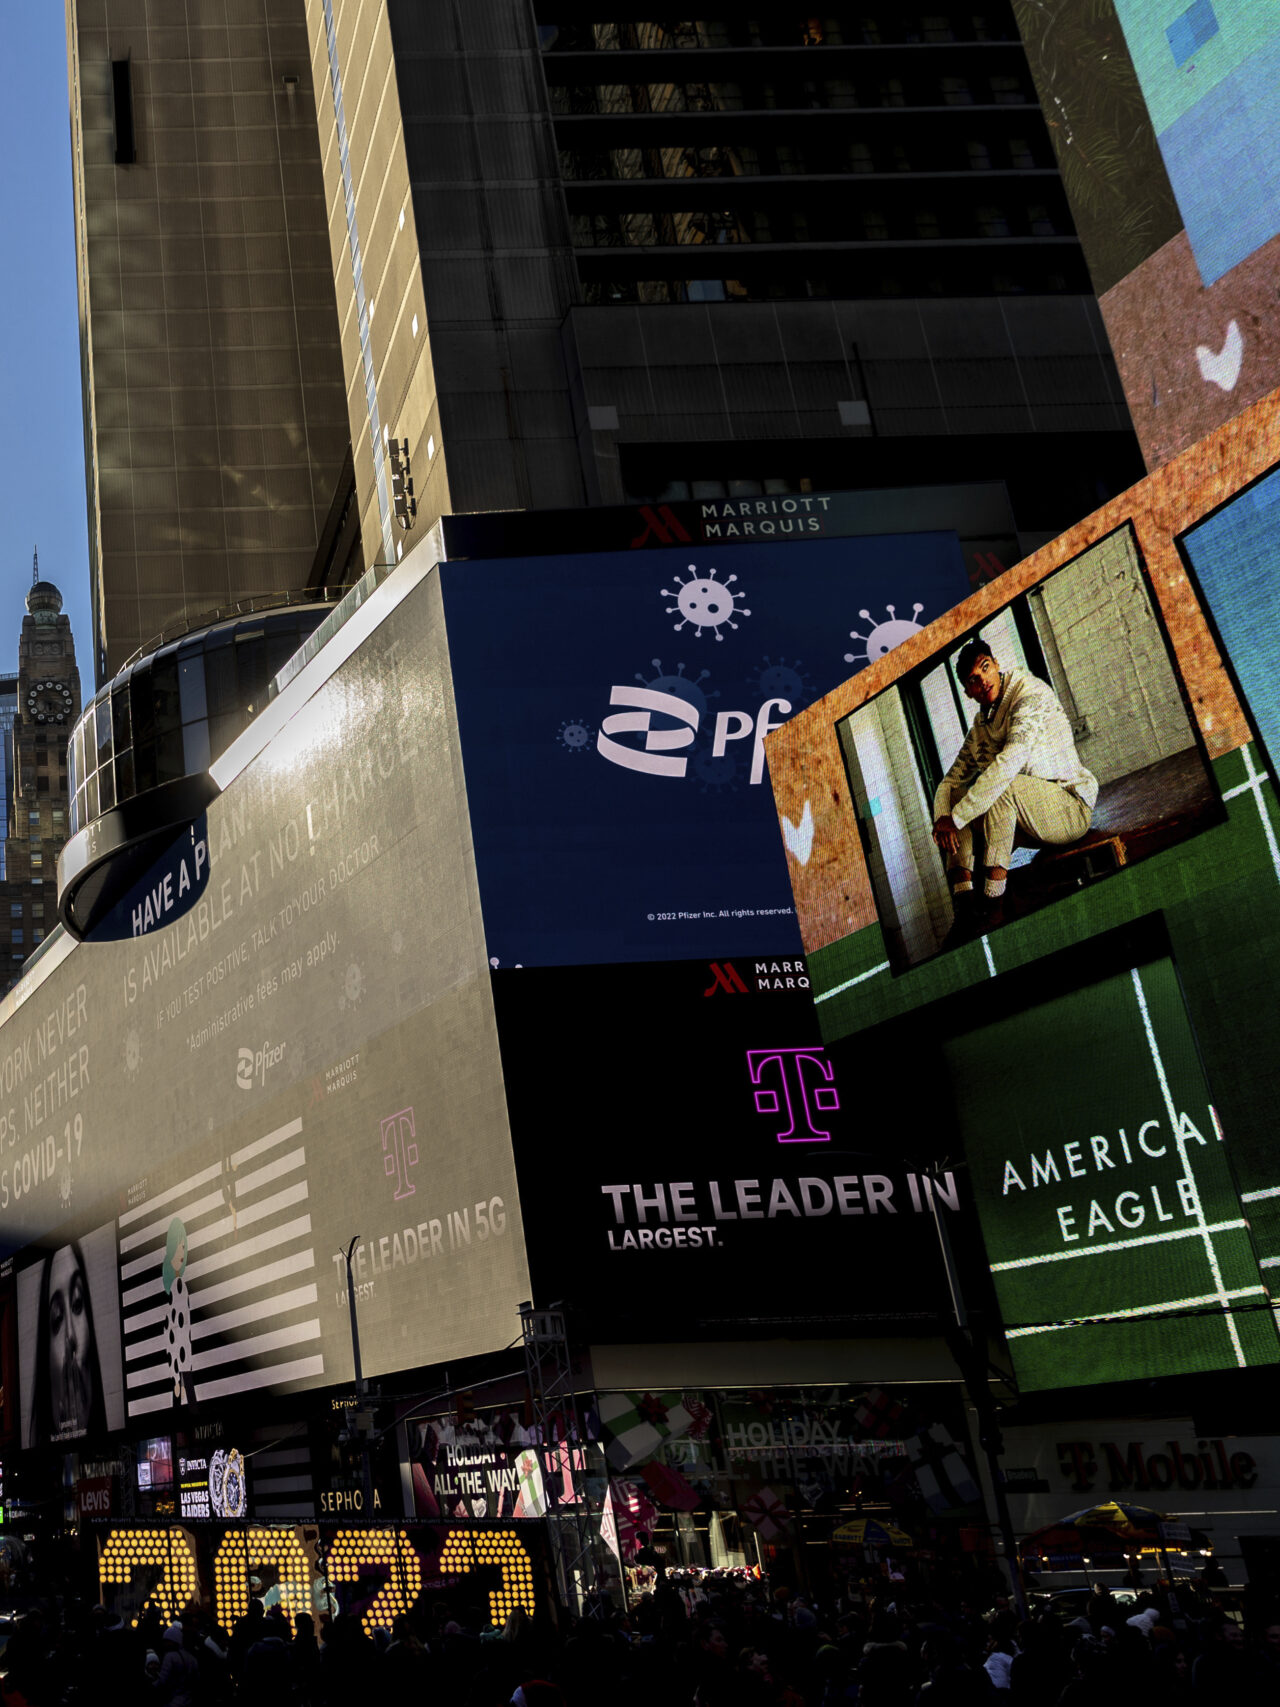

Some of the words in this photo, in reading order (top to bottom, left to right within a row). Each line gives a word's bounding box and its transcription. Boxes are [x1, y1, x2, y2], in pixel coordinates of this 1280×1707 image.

[701, 496, 831, 519] MARRIOTT
[705, 516, 821, 538] MARQUIS
[132, 872, 174, 942] HAVE
[179, 859, 190, 898] A
[657, 912, 676, 920] 2022
[678, 911, 701, 920] Pfizer
[703, 910, 717, 919] Inc.
[718, 909, 730, 918] All
[731, 908, 755, 919] rights
[756, 906, 794, 916] reserved.
[123, 967, 138, 1008] IS
[142, 880, 234, 993] AVAILABLE
[240, 850, 262, 906] AT
[166, 996, 182, 1022] YOU
[183, 977, 204, 1008] TEST
[252, 917, 278, 952] TALK
[279, 903, 293, 929] TO
[257, 977, 279, 1003] fees
[281, 956, 303, 985] may
[307, 930, 341, 967] apply.
[755, 961, 805, 974] MARR
[758, 976, 810, 990] MARQ
[36, 983, 88, 1066] NEVER
[255, 1040, 287, 1088] Pfizer
[326, 1053, 361, 1081] MARRIOTT
[24, 1044, 91, 1136] NEITHER
[327, 1069, 358, 1095] MARQUIS
[13, 1112, 84, 1202] COVID-19
[601, 1181, 700, 1224] THE
[708, 1174, 898, 1221] LEADER
[906, 1171, 962, 1214] IN
[1057, 1178, 1202, 1242] EAGLE
[370, 1217, 445, 1275] LEADER
[447, 1206, 472, 1252] IN
[475, 1195, 506, 1241] 5G
[607, 1226, 725, 1251] LARGEST.
[727, 1420, 842, 1449] HOLIDAY
[186, 1458, 208, 1472] INVICTA
[447, 1444, 497, 1467] HOLIDAY
[1100, 1440, 1258, 1491] Mobile
[181, 1492, 191, 1505] LAS
[191, 1490, 210, 1504] VEGAS
[181, 1504, 211, 1518] RAIDERS
[320, 1487, 382, 1512] SEPHOA
